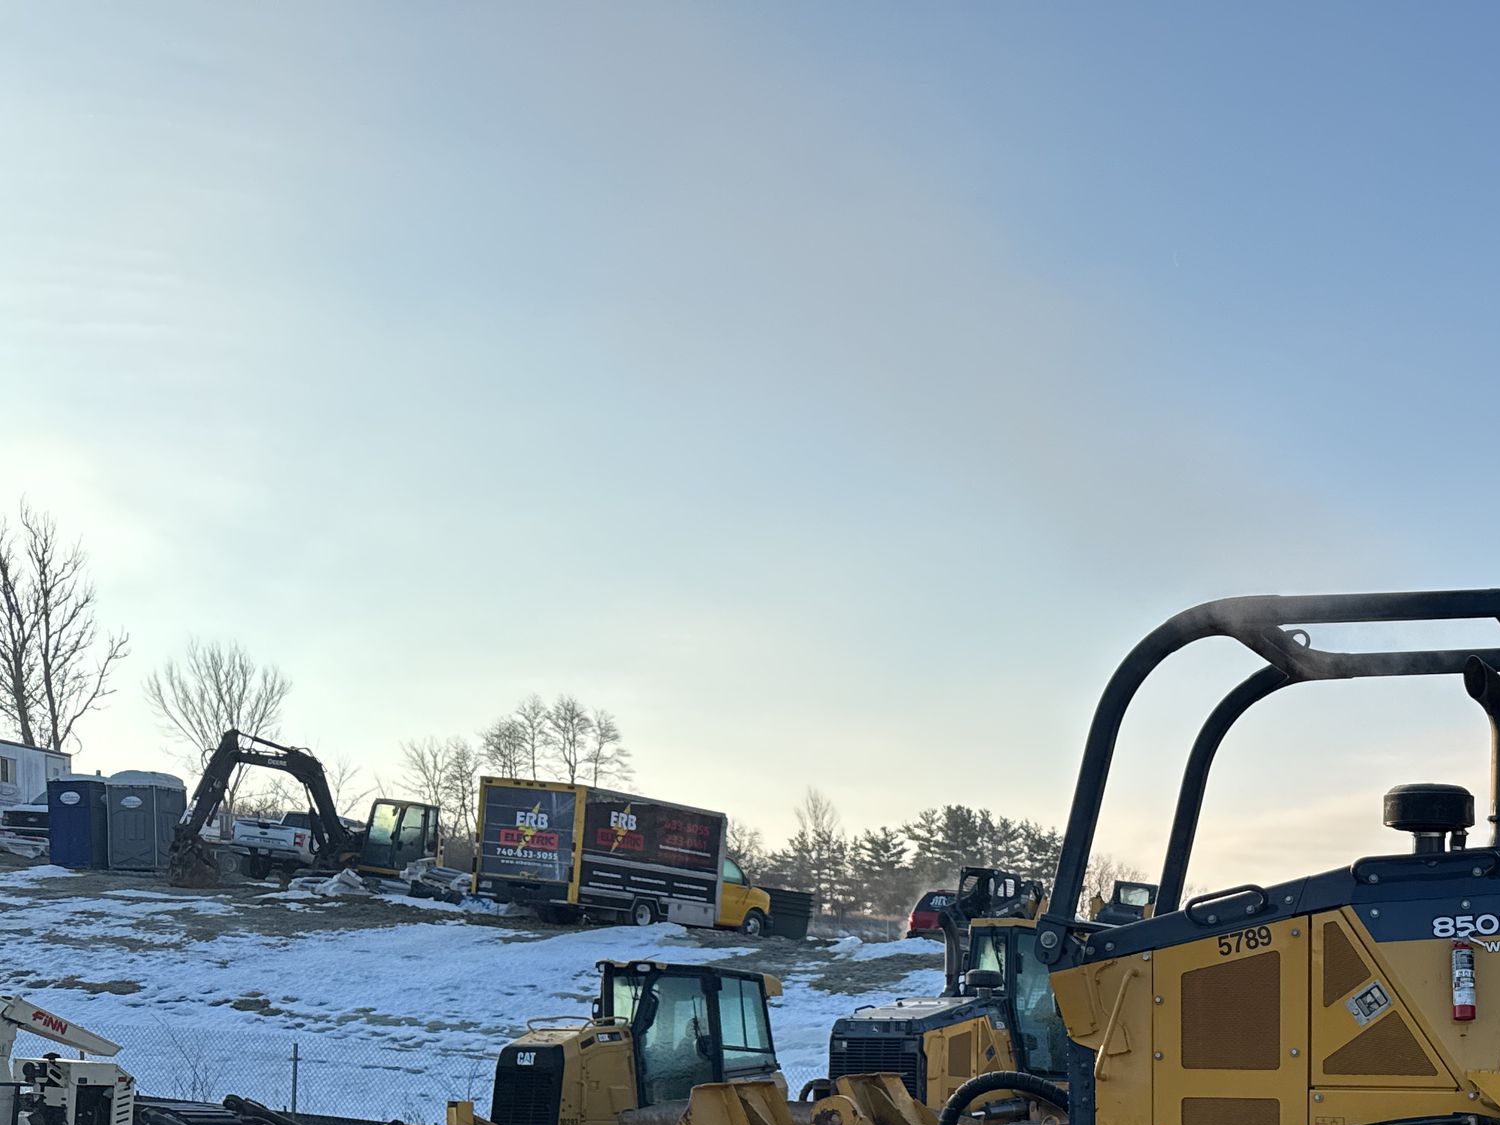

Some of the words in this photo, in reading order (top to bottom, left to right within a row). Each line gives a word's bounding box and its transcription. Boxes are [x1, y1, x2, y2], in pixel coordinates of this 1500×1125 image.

[516, 811, 548, 830] ERB
[610, 811, 636, 831] ERB
[504, 832, 556, 847] ELECTRIC
[497, 847, 558, 860] 740-633-5055
[1218, 926, 1272, 956] 5789
[517, 1052, 536, 1065] CAT
